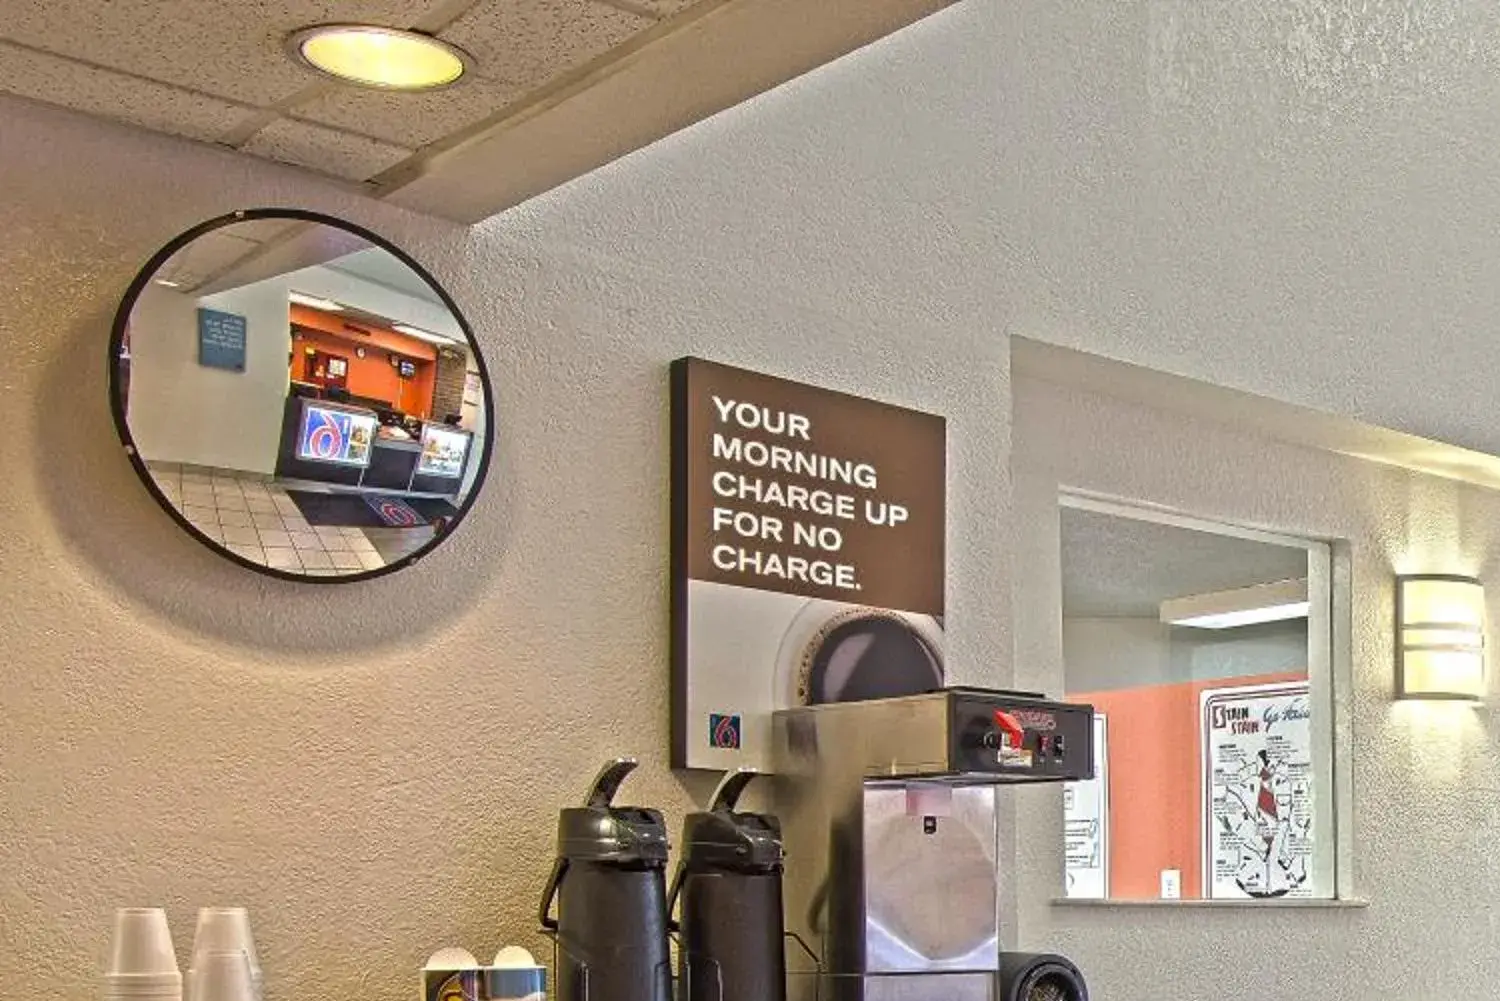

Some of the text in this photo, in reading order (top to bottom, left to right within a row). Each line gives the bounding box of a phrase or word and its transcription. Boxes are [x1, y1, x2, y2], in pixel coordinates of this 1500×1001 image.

[712, 395, 811, 441] YOUR
[712, 433, 878, 489] MORNING
[712, 470, 910, 529] CHARGE UP
[712, 507, 843, 552] FOR NO
[712, 544, 863, 591] CHARGE.
